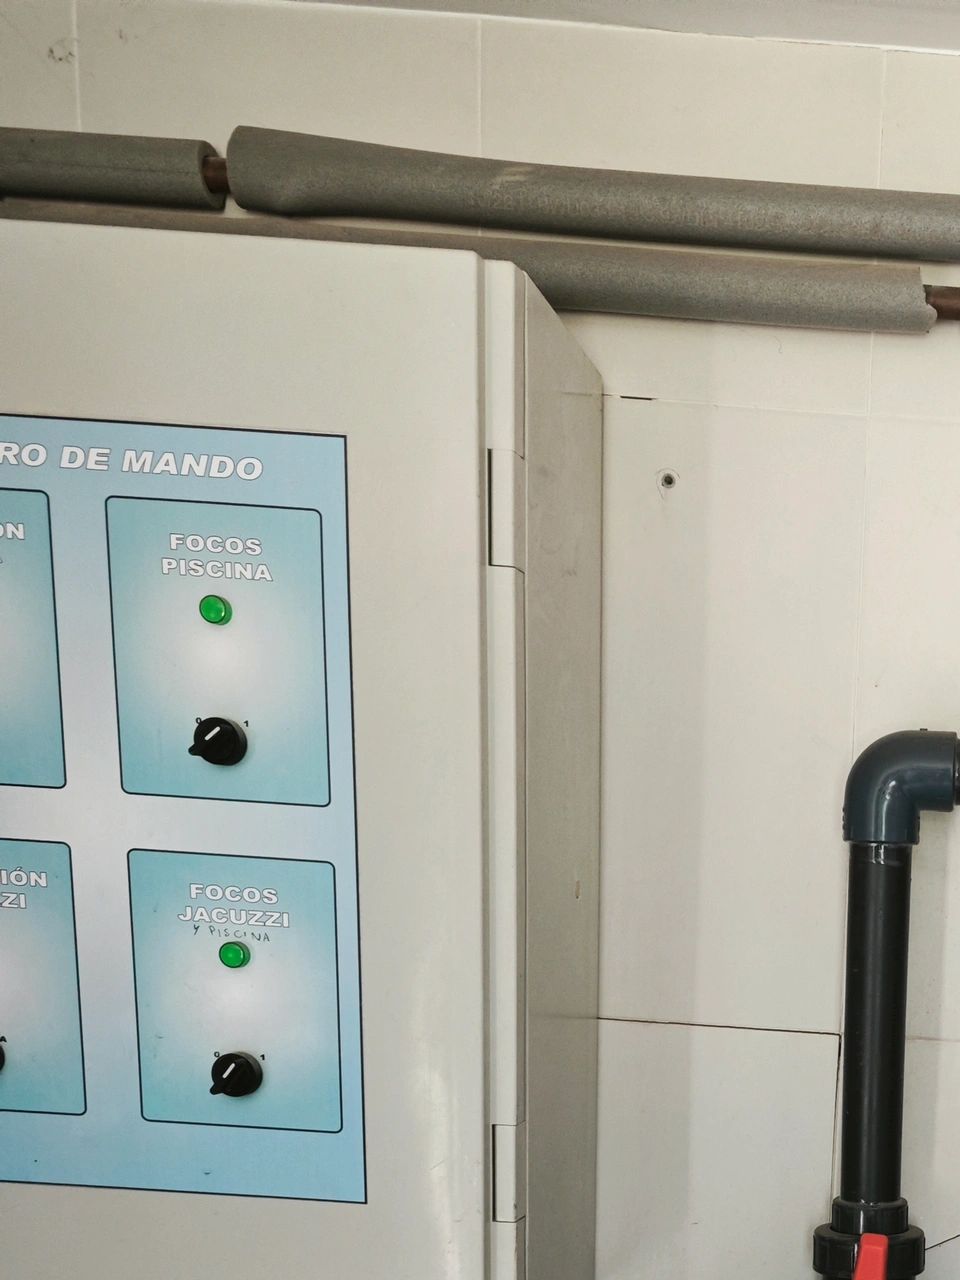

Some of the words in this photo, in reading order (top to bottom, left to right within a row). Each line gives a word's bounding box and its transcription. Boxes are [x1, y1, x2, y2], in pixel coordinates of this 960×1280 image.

[59, 446, 111, 471] DE
[121, 450, 264, 481] MANDO
[169, 532, 263, 556] FOCOS
[161, 557, 274, 582] PISCINA
[189, 883, 279, 905] FOCOS
[177, 906, 291, 929] JACUZZI
[208, 925, 271, 943] PISCINA
